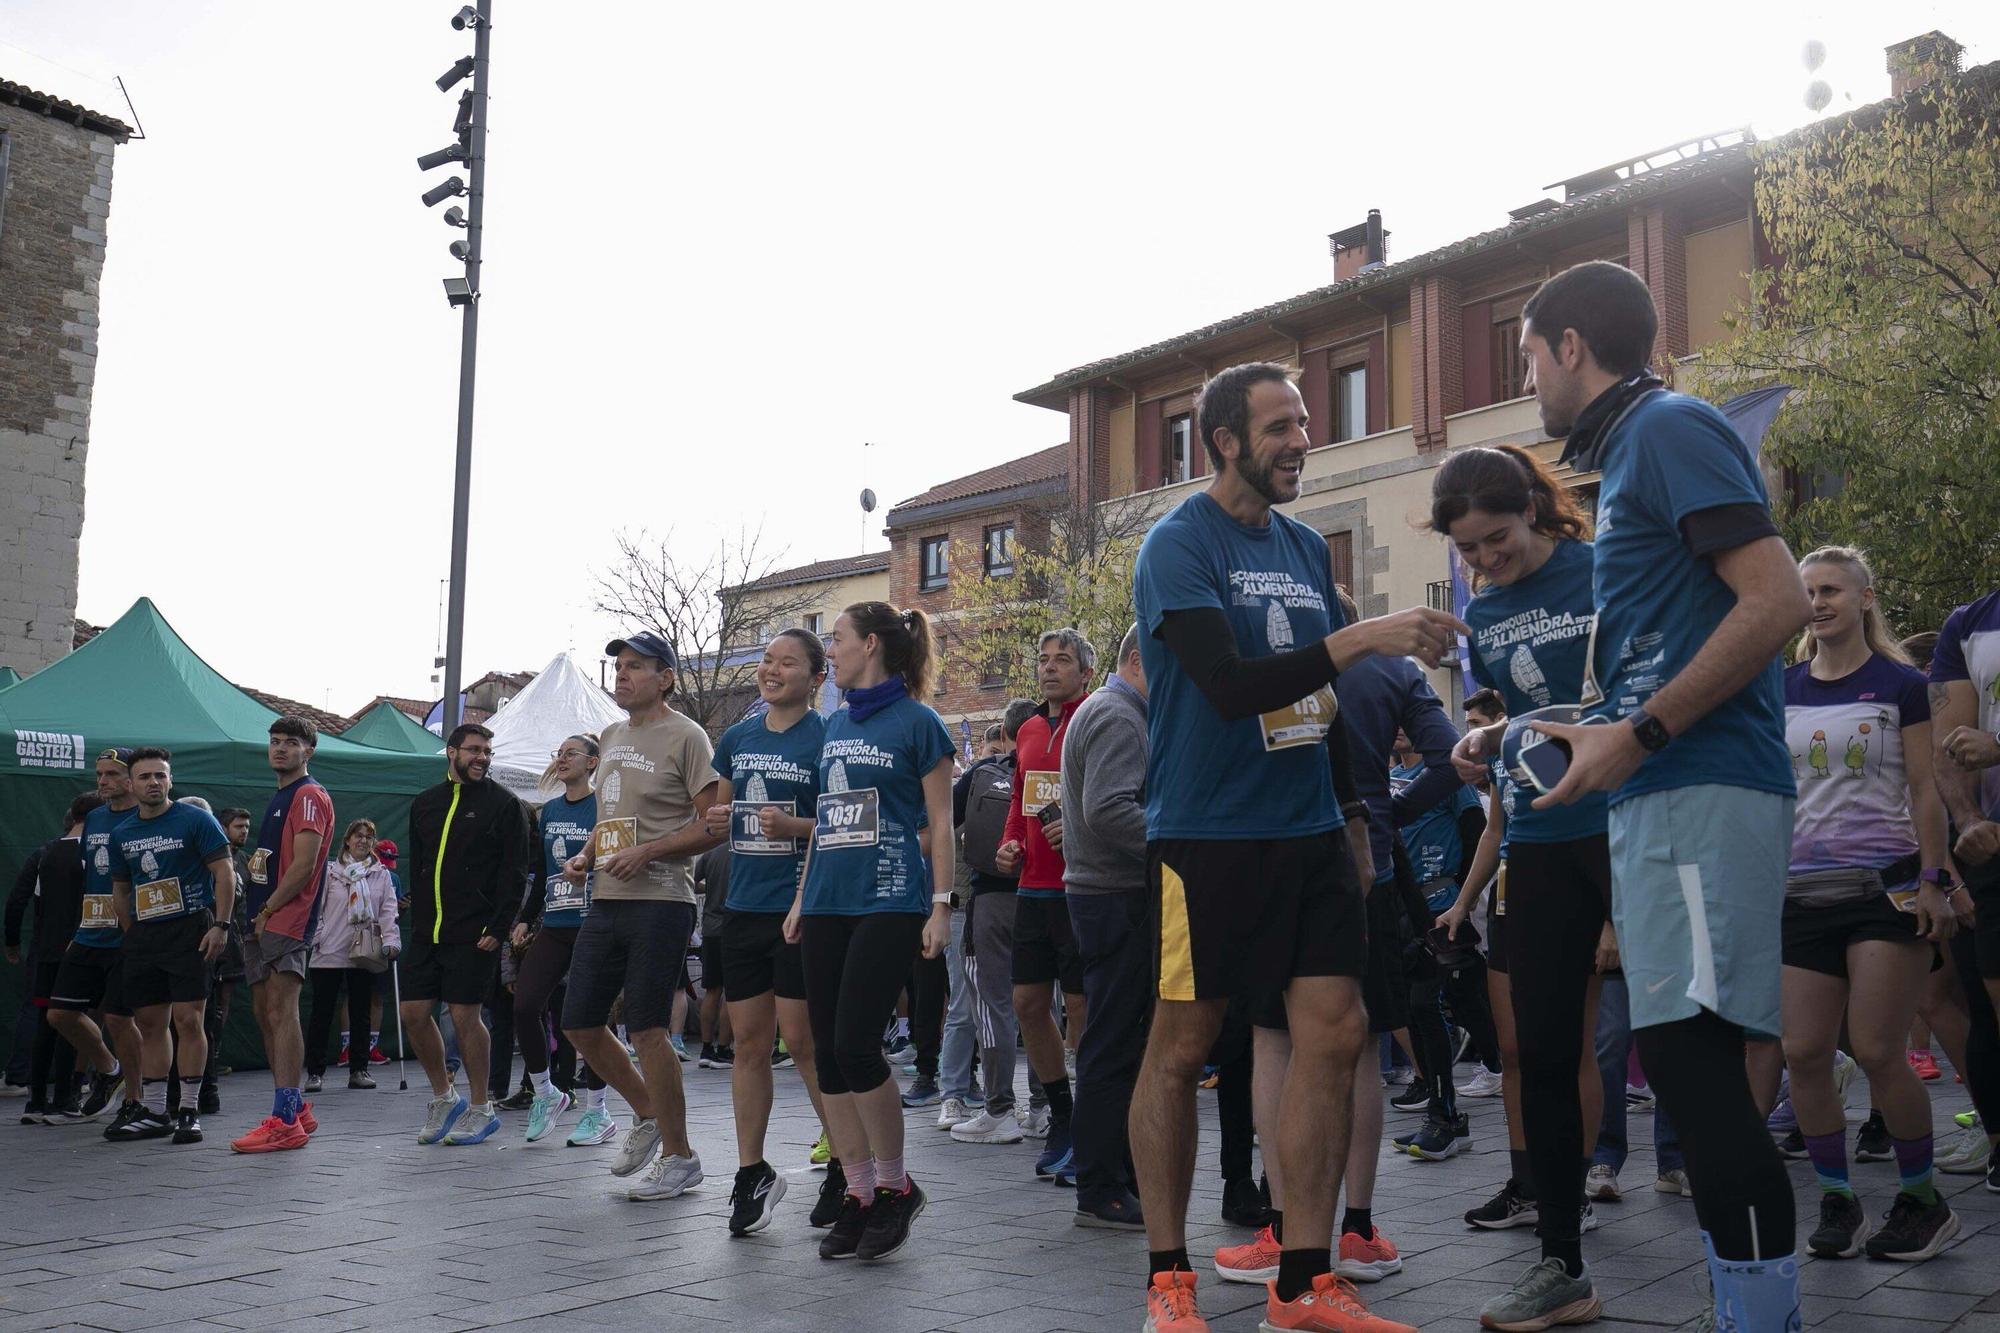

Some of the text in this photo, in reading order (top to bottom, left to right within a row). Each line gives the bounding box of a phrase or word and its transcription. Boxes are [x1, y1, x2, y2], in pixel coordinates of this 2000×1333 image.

[1236, 571, 1293, 583] CONQUISTA
[1243, 581, 1316, 598] ALMENDRA
[1478, 608, 1549, 640] LA CONQUISTA
[1492, 612, 1575, 650] ALMENDRA
[14, 729, 72, 745] VITORIA
[16, 741, 72, 759] GASTEIZ
[737, 753, 782, 762] CONQUISTA
[879, 751, 893, 760] REN
[20, 757, 72, 769] green capital
[621, 761, 655, 773] KONKISTA
[736, 761, 798, 773] ALMENDRA
[798, 768, 811, 776] REN
[846, 756, 893, 768] KONKISTA
[765, 771, 811, 784] KONKISTA
[1036, 782, 1061, 800] 326
[826, 803, 864, 827] 1037
[128, 835, 162, 846] CONQUISTA
[130, 837, 174, 852] ALMENDRA
[147, 889, 165, 904] 54
[553, 881, 573, 897] 987
